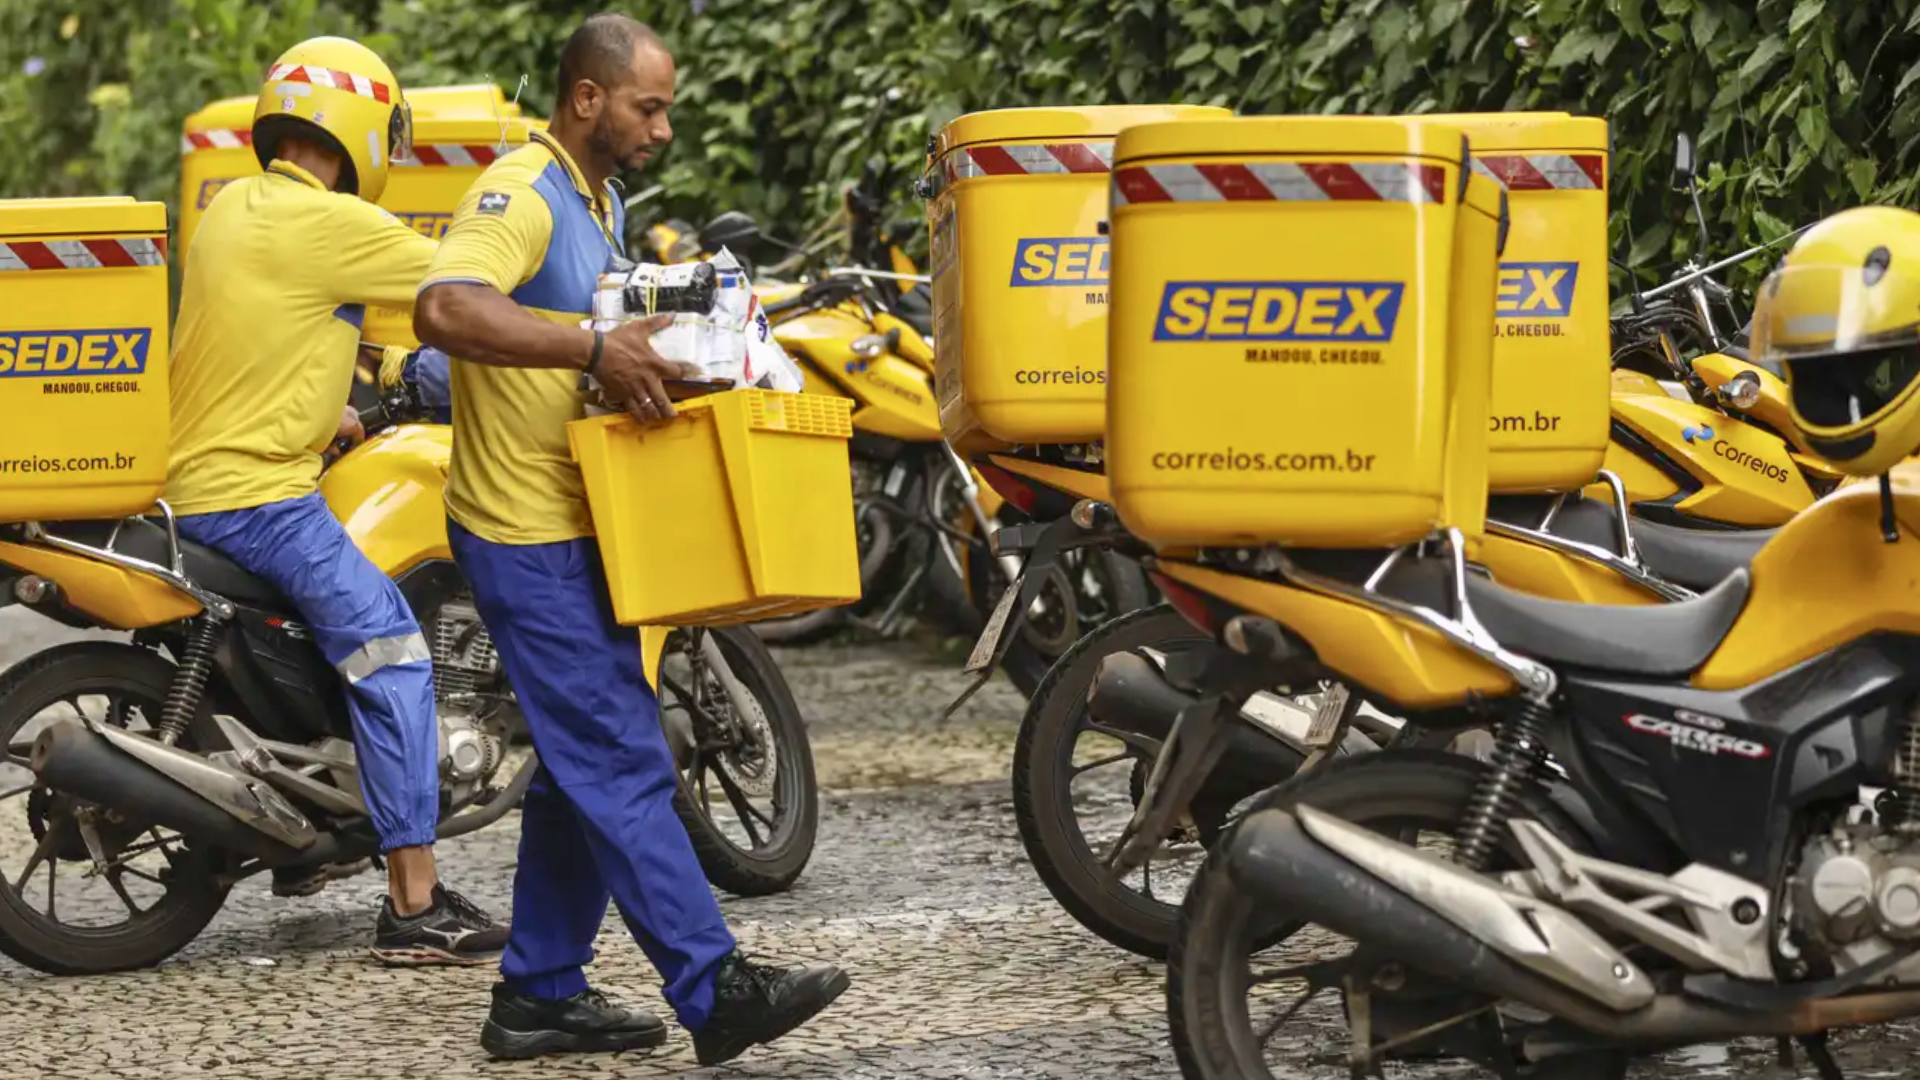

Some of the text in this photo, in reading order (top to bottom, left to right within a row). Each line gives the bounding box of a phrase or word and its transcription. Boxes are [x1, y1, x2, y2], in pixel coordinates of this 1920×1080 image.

[1164, 287, 1392, 336] SEDEX
[1507, 323, 1565, 337] CHEGOU.
[1246, 349, 1386, 365] MANDOU, CHEGOU.
[43, 381, 141, 395] MANDOU, CHEGOU.
[0, 452, 136, 473] rreios.com.br
[1151, 446, 1377, 472] correios.com.br
[1713, 439, 1788, 483] Correios
[1626, 714, 1766, 757] CARGO
